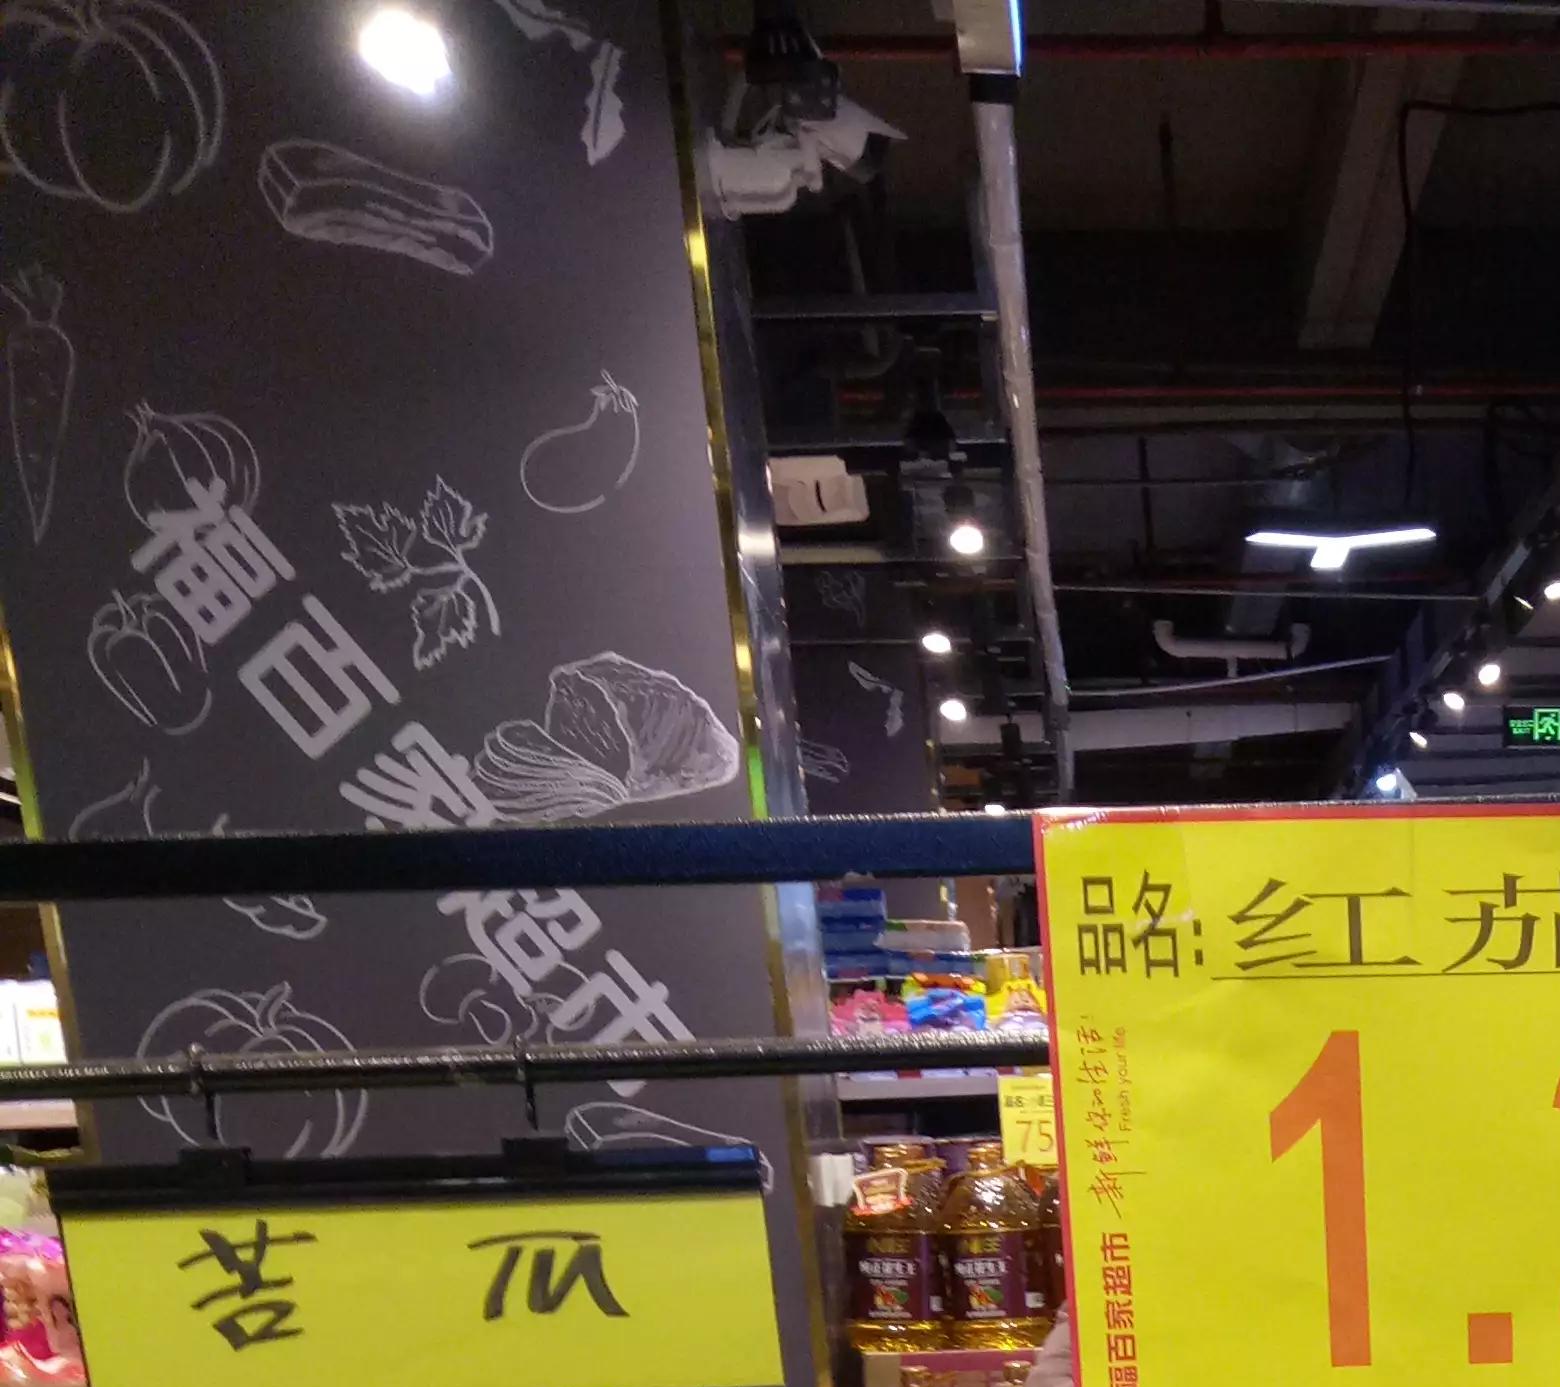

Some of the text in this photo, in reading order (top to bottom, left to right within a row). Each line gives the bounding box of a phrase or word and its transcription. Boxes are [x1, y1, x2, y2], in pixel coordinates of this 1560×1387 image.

[1112, 1026, 1132, 1132] Fresh your life
